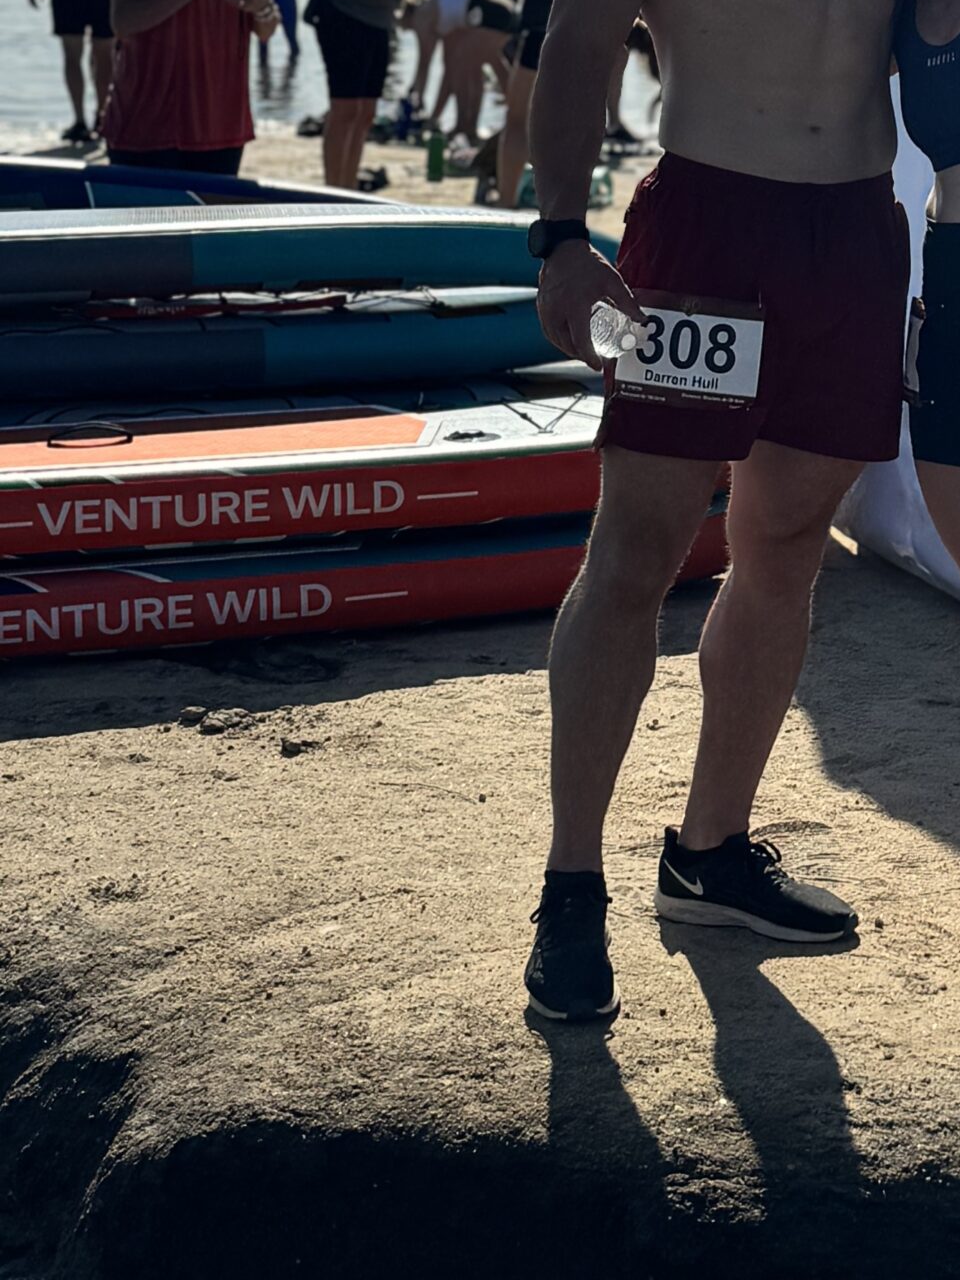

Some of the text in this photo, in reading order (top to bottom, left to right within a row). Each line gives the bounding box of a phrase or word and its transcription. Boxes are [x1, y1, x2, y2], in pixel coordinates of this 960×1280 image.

[636, 314, 737, 374] 308
[644, 369, 688, 387] Darren
[692, 375, 719, 391] Hull
[37, 480, 405, 536] VENTURE WILD
[0, 583, 332, 645] ENTURE WILD
